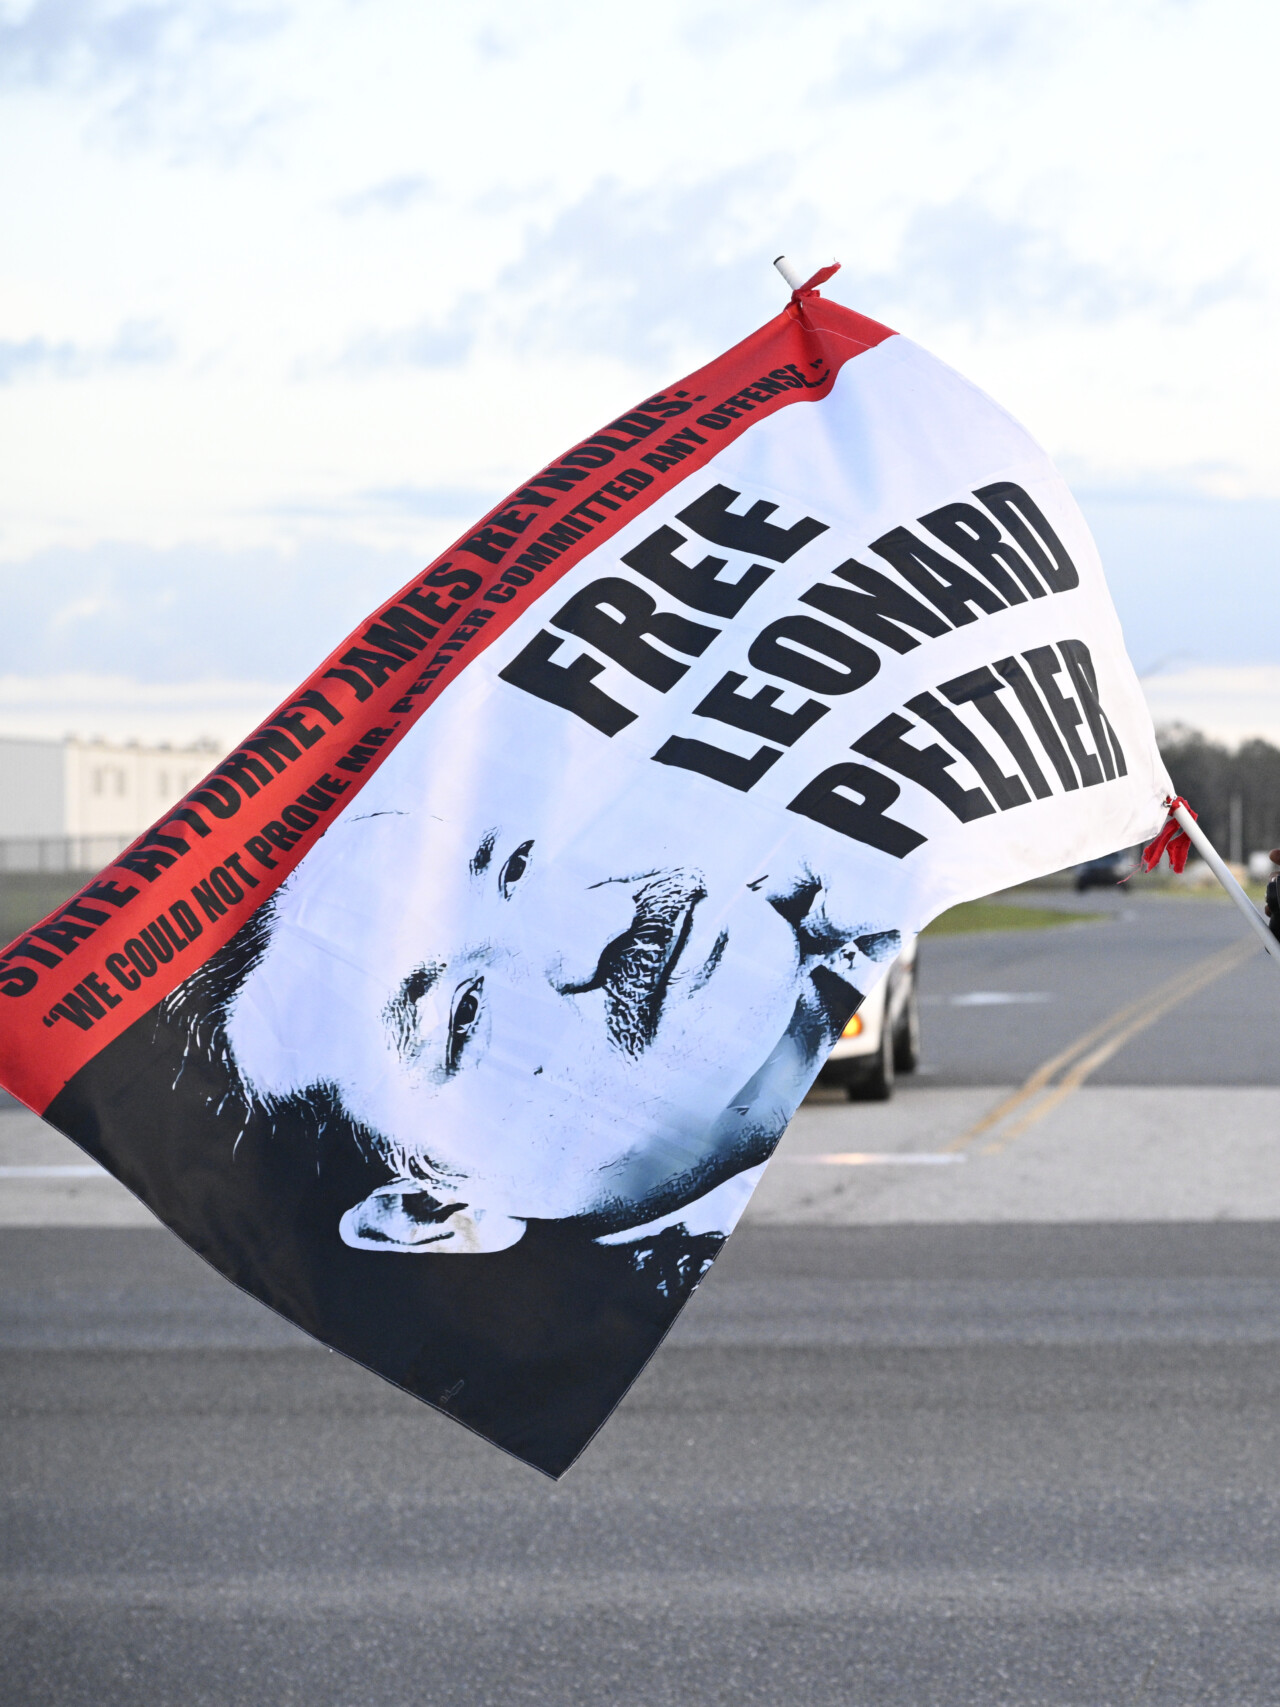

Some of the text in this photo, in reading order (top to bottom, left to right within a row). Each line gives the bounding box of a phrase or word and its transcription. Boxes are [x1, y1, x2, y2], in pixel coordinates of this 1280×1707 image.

[107, 899, 203, 990] COULD
[195, 851, 261, 926] NOT
[244, 773, 353, 870] PROVE
[347, 720, 401, 777] MR.
[388, 597, 496, 714] PELTIER
[483, 468, 654, 604] COMMITTED
[641, 427, 709, 474] ANY
[498, 484, 830, 737] FREE
[651, 481, 1080, 793] LEONARD
[786, 638, 1128, 859] PELTIER
[0, 879, 140, 998] STATE
[322, 562, 483, 703] JAMES
